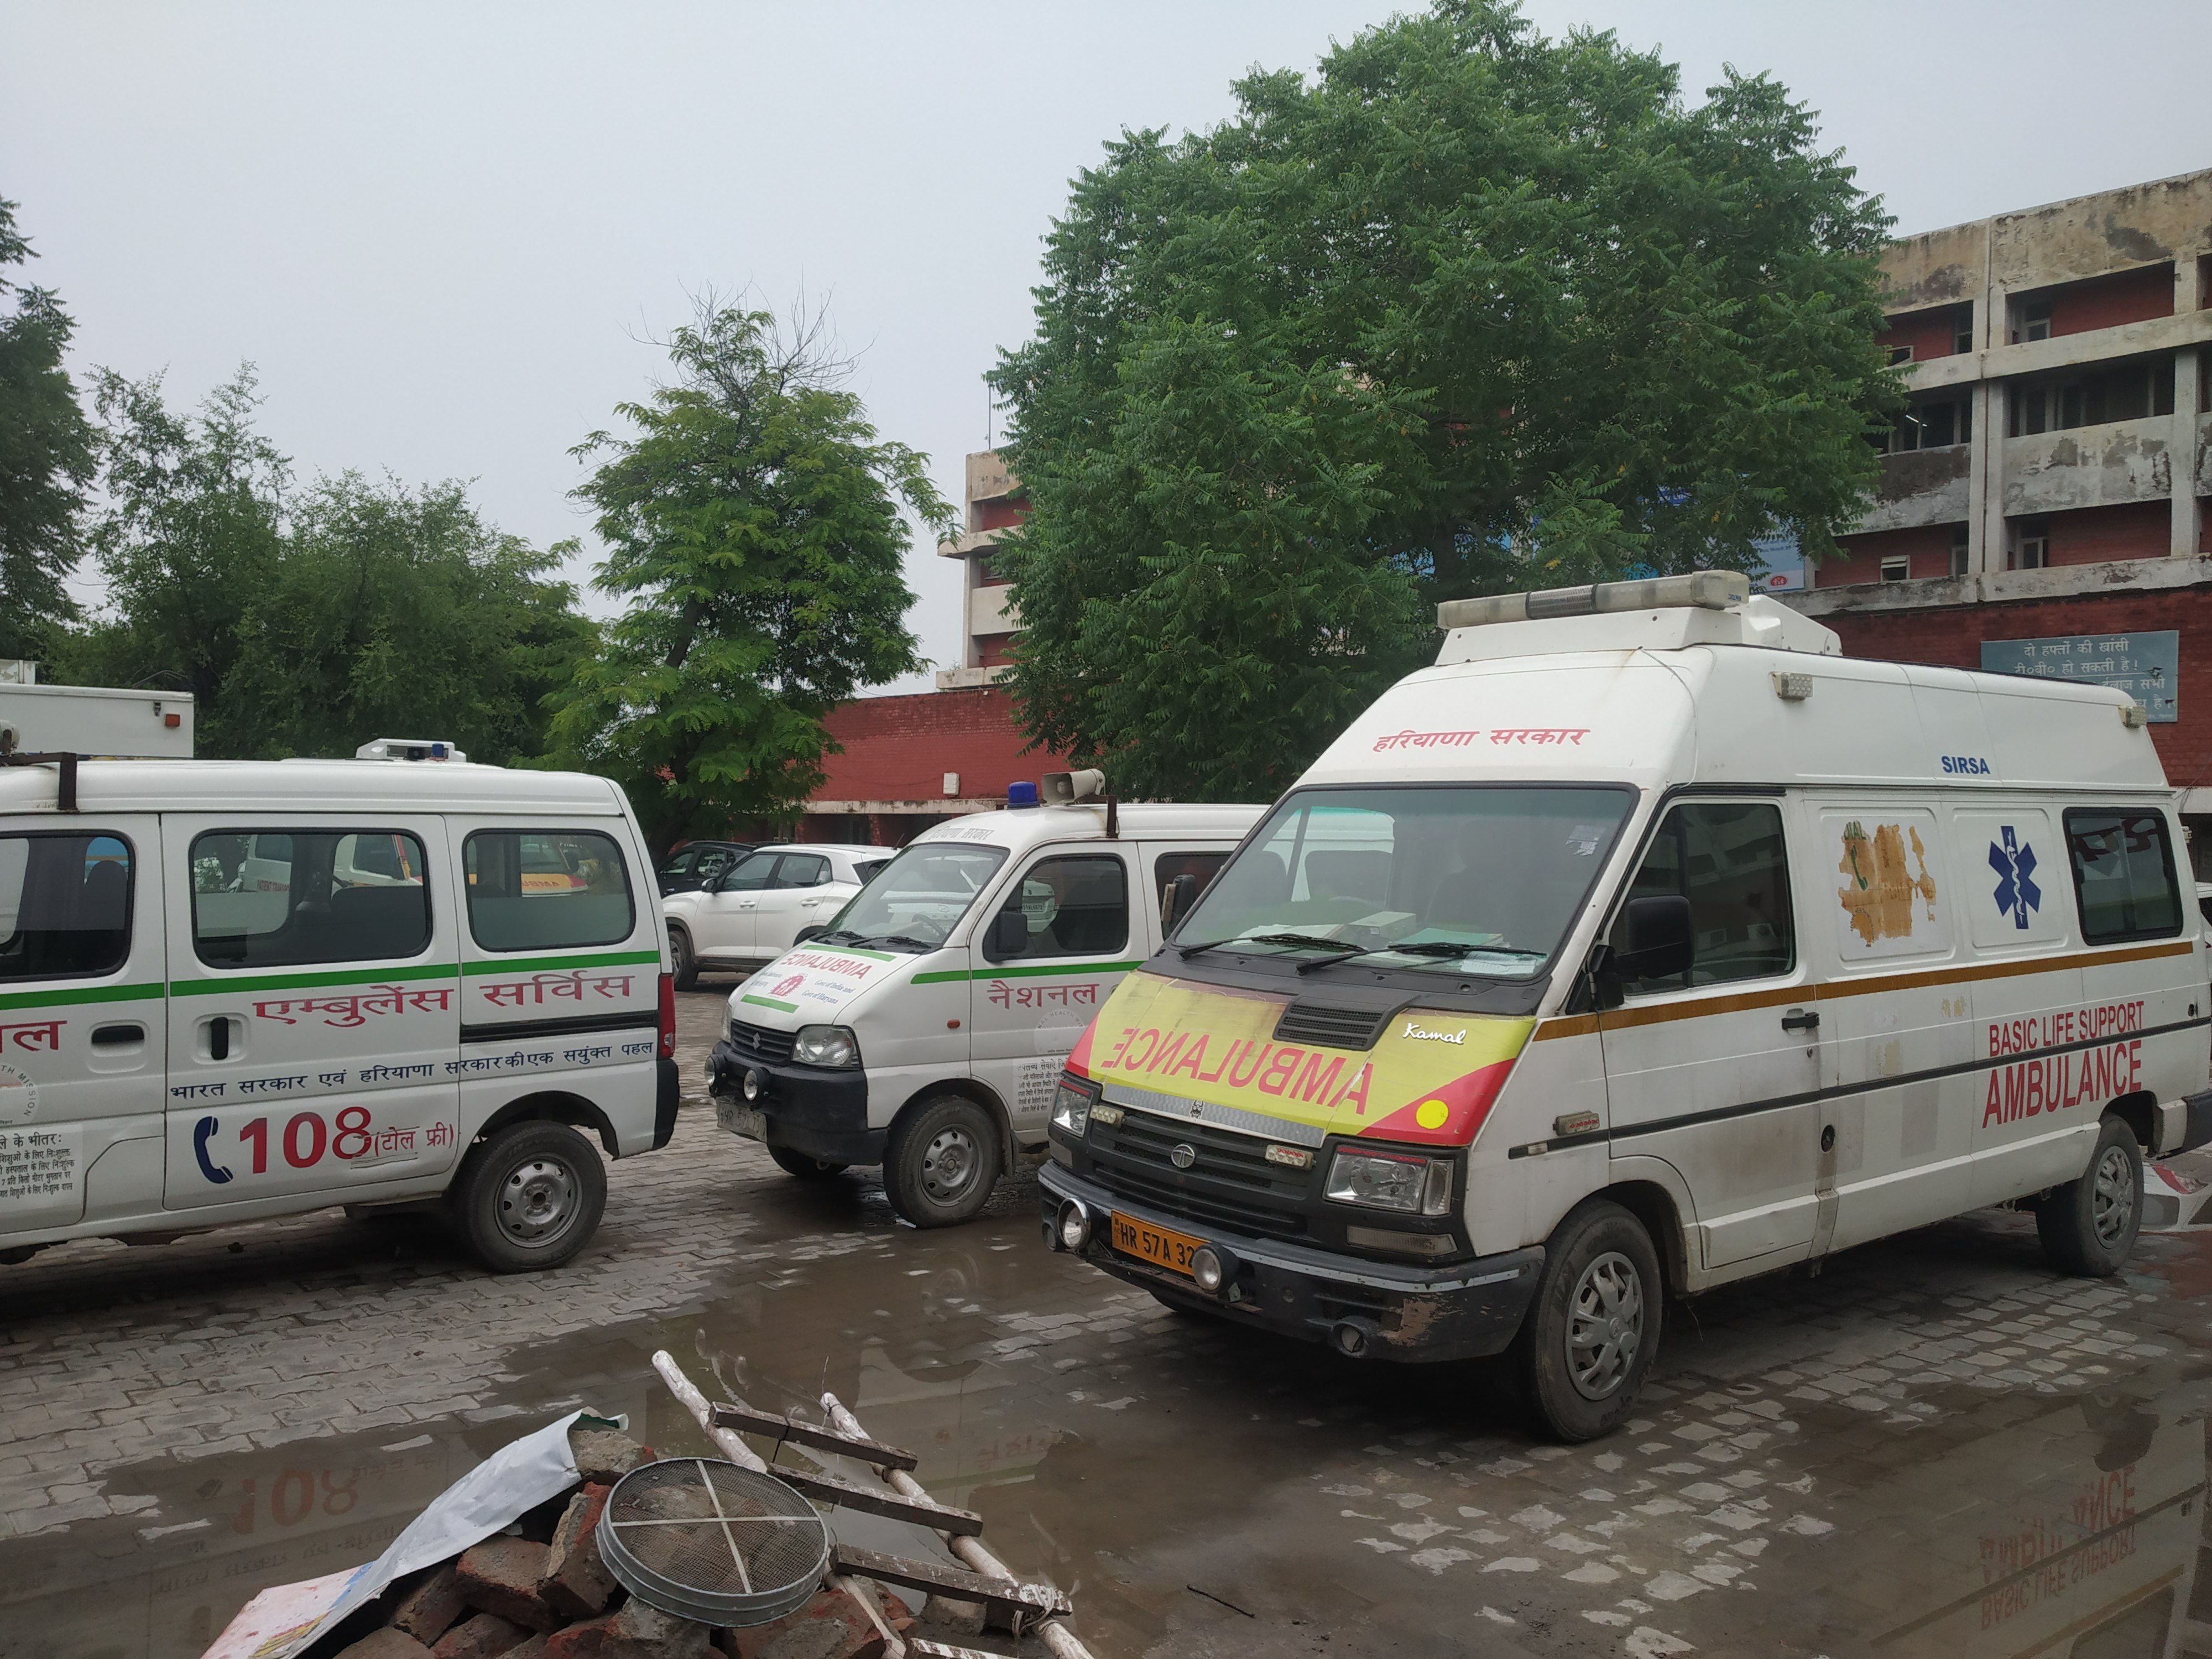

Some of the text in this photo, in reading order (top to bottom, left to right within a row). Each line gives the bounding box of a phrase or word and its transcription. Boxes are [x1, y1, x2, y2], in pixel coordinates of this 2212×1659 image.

[2024, 638, 2129, 658] दो हफ्तों की खांसी
[2062, 660, 2074, 674] हो
[2080, 658, 2114, 673] सकती
[1373, 729, 1591, 753] हरियाणा सरकार
[1941, 755, 1990, 775] SIRSA
[252, 971, 635, 1027] एम्बुलेंस सर्विस
[987, 980, 1100, 1010] नैशनल
[1402, 1022, 1467, 1045] Kamal
[1989, 1000, 2145, 1057] BASIC LIFE SUPPORT
[170, 1082, 226, 1099] भारत
[238, 1075, 308, 1094] सरकार
[318, 1069, 347, 1087] एवं
[359, 1063, 434, 1083] हरियाणा
[445, 1057, 503, 1074] सरकार
[621, 1041, 654, 1056] पहल
[1982, 1039, 2142, 1129] AMBULANCE
[13, 1133, 24, 1148] के
[239, 1106, 372, 1175] 108
[24, 1150, 30, 1160] के
[32, 1150, 44, 1160] लिए
[31, 1162, 36, 1171] के
[38, 1161, 50, 1170] लिए
[1120, 1222, 1138, 1250] HR
